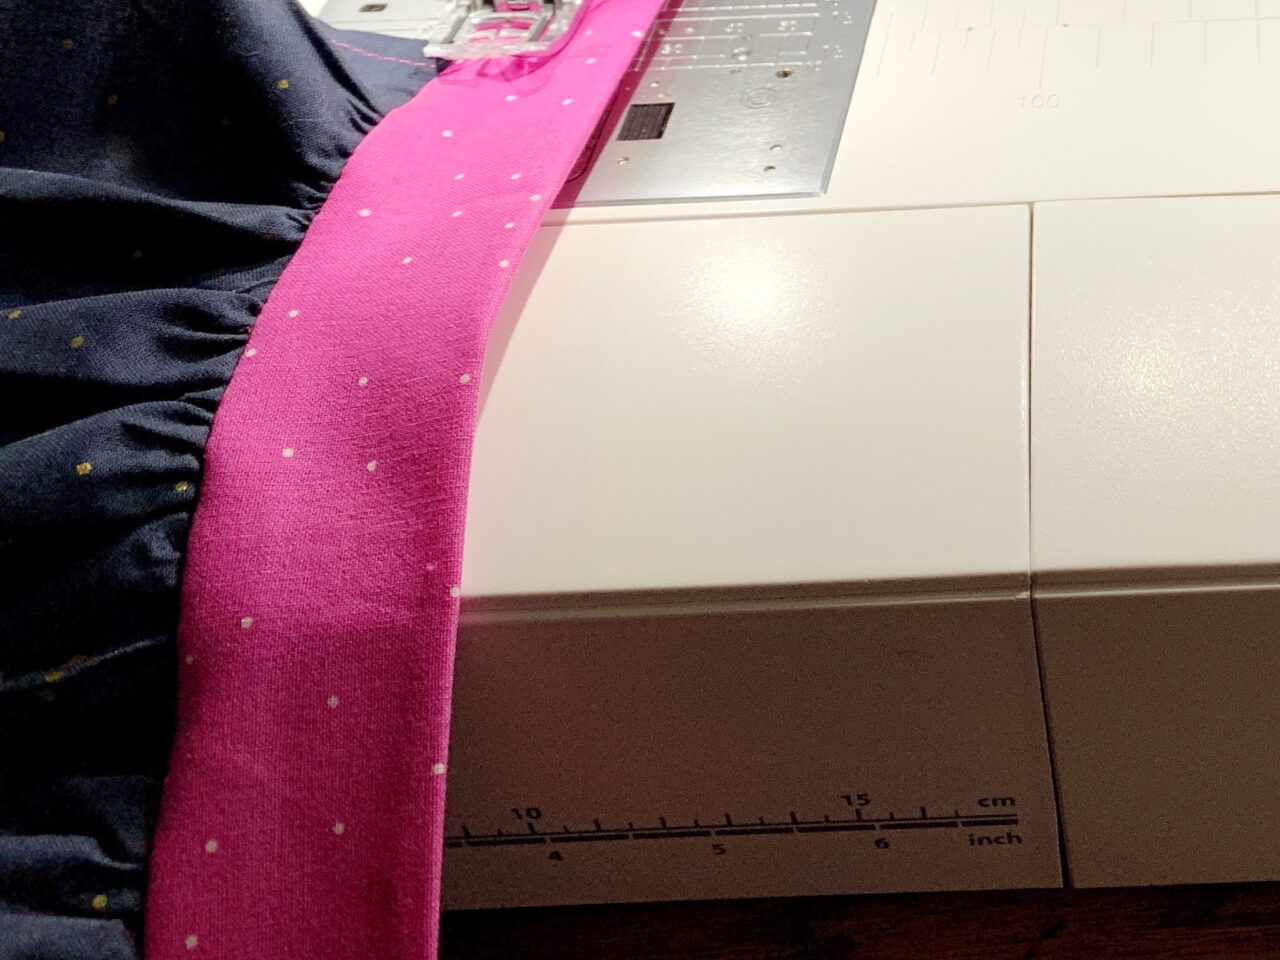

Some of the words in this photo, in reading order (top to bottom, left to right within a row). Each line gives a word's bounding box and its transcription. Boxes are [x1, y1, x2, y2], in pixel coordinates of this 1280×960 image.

[1018, 93, 1060, 109] 100
[511, 807, 541, 819] 10
[842, 793, 870, 806] 15
[978, 794, 1016, 808] cm
[548, 851, 563, 861] 4
[713, 844, 726, 855] 5
[874, 838, 889, 849] 6
[969, 832, 1022, 847] inch
